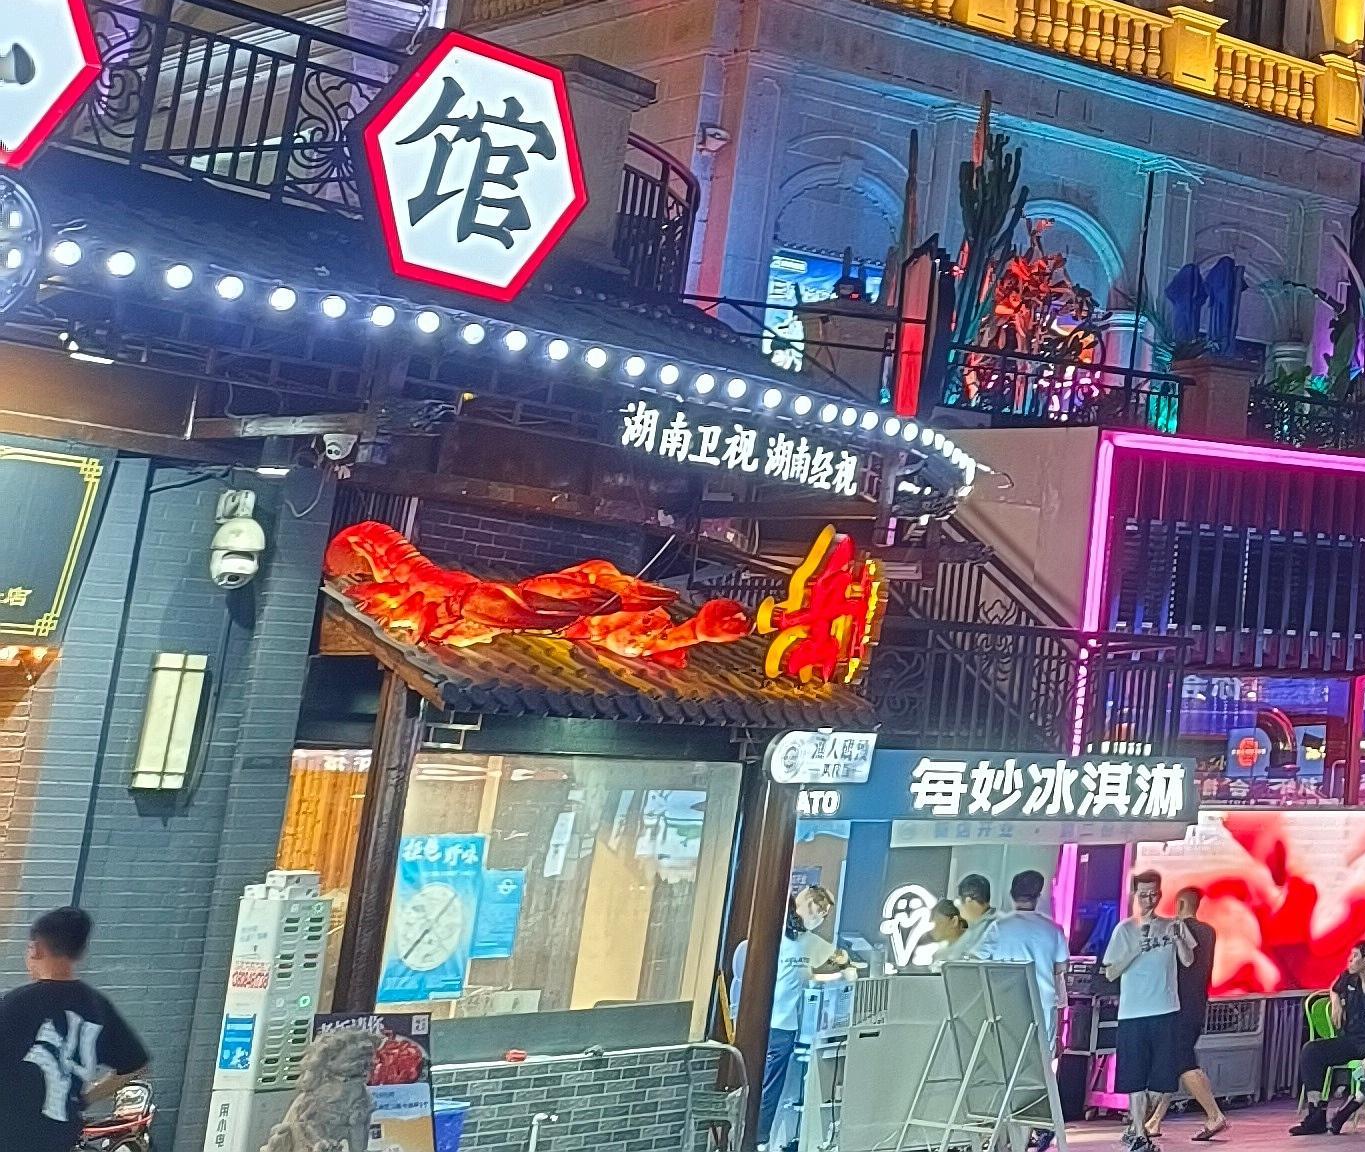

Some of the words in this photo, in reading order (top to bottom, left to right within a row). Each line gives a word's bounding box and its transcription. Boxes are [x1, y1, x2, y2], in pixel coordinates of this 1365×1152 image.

[397, 77, 556, 249] 馆
[621, 401, 759, 473] 湖南卫视
[764, 433, 858, 496] 湖南经视
[910, 758, 1185, 818] 每妙冰淇淋
